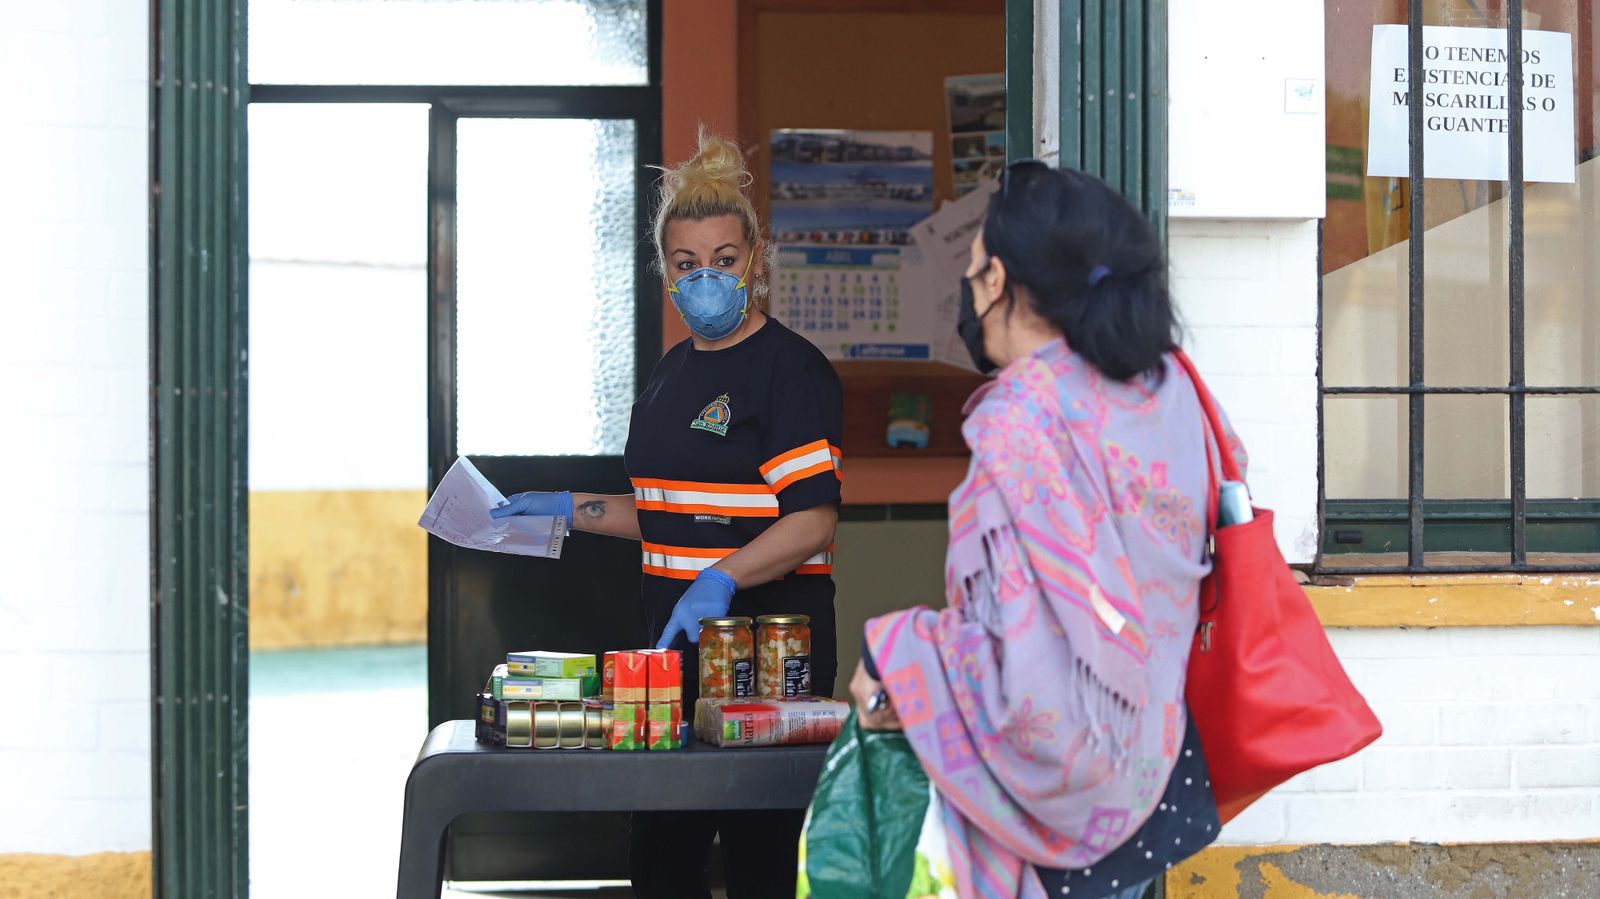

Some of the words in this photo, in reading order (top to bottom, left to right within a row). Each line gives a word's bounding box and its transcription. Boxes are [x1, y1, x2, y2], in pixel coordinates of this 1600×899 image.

[1531, 73, 1556, 88] DE
[1392, 91, 1536, 111] MSCARILLS
[1542, 98, 1556, 112] O
